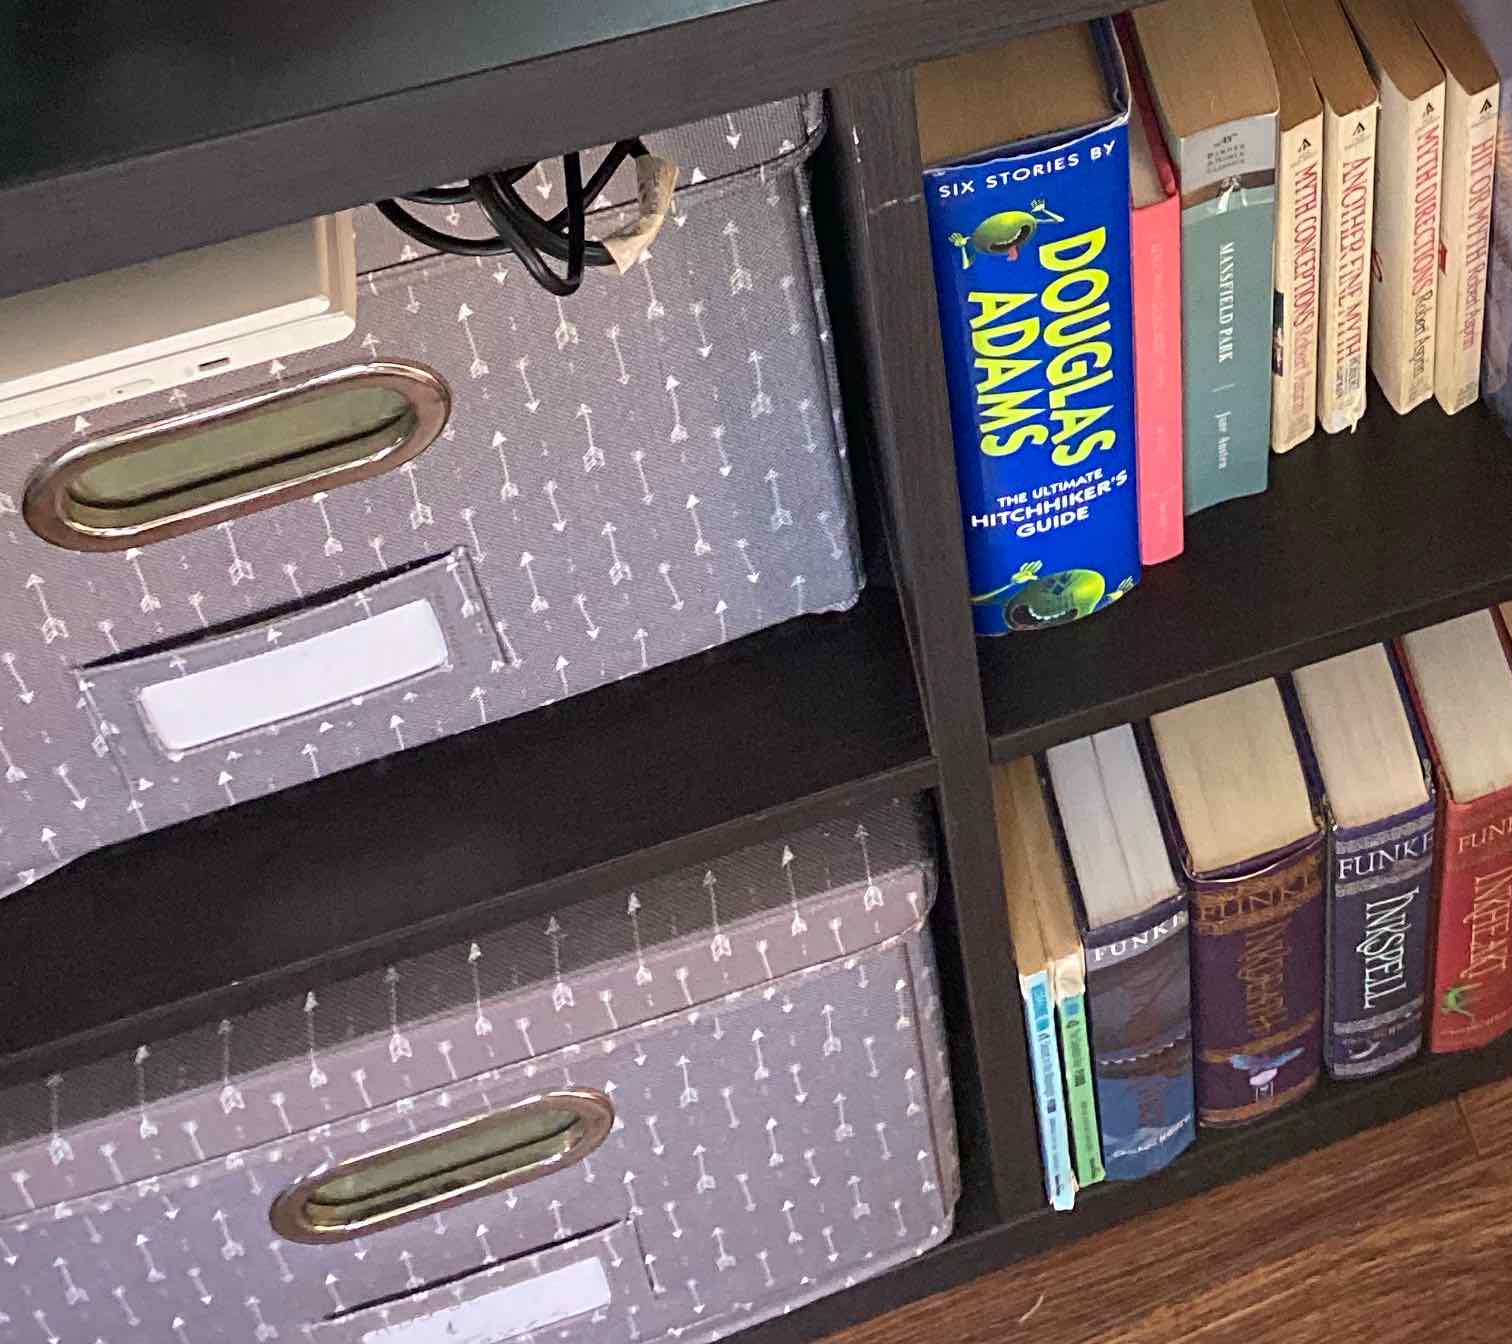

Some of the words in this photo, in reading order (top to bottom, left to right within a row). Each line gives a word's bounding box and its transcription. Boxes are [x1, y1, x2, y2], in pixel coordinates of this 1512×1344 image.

[938, 180, 976, 199] SIX
[984, 151, 1081, 190] STORIES
[1089, 138, 1119, 171] BY
[1414, 124, 1440, 182] MYTH
[1469, 135, 1495, 177] HIT
[1293, 160, 1319, 214] MYTH
[1340, 155, 1373, 253] ANOTHER
[1468, 176, 1491, 210] OR
[1411, 182, 1437, 297] DIRECTIONS
[1465, 208, 1489, 266] MYTH
[1216, 240, 1236, 321] MANSFIELD
[1293, 215, 1319, 330] CONCEPTIONS
[1038, 225, 1117, 467] DOUGLAS
[1216, 322, 1233, 365] PARK
[1336, 301, 1362, 364] MYTH
[967, 289, 1051, 458] ADAMS
[970, 470, 1129, 529] HITCHHIKER'S
[996, 489, 1029, 511] THE
[1030, 467, 1104, 502] ULTIMATE
[1015, 505, 1091, 539] GUIDE
[1356, 885, 1421, 1010] INKSPELL
